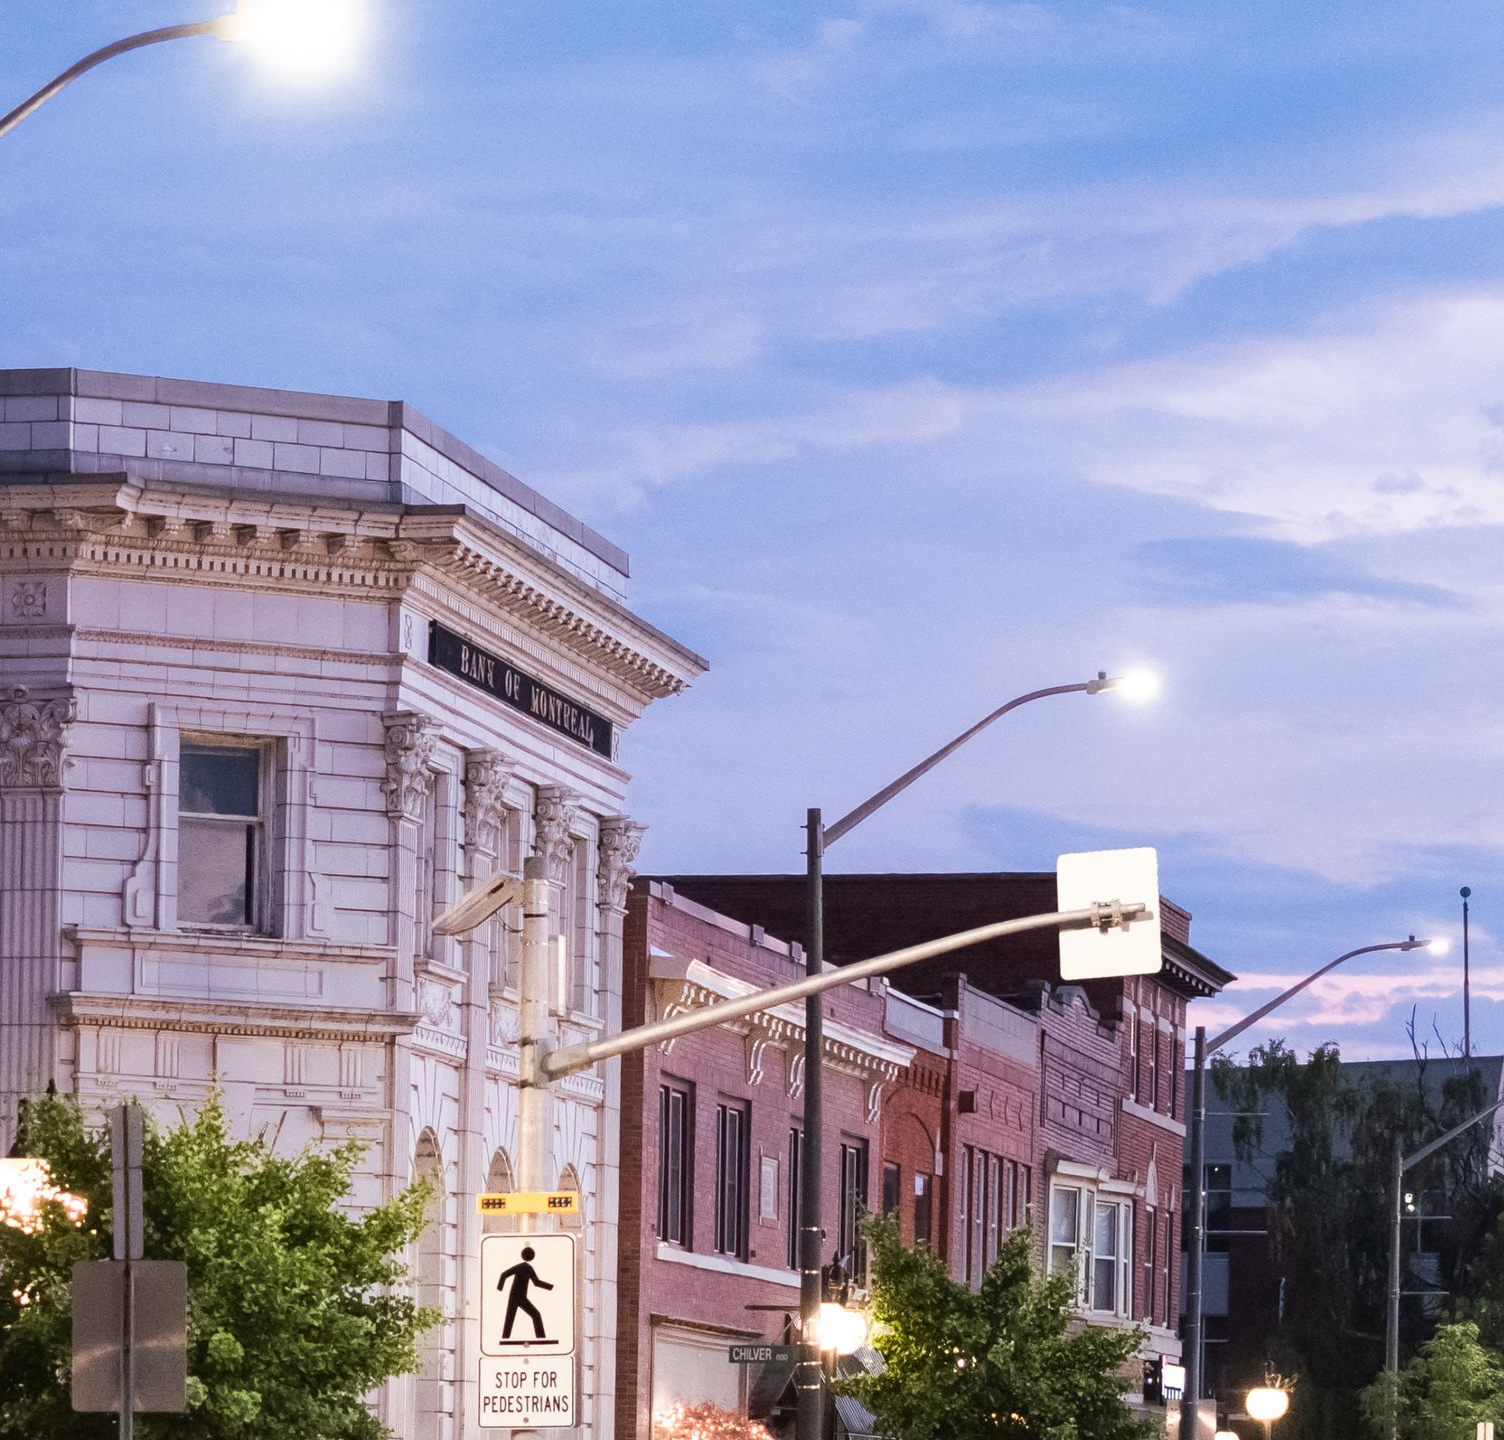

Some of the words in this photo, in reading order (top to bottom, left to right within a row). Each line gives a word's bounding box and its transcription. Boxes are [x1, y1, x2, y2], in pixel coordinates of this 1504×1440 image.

[460, 644, 495, 688] BANK
[505, 669, 522, 701] OF
[530, 685, 594, 749] MONTREAL
[732, 1347, 772, 1361] CHILVER
[495, 1371, 527, 1389] STOP
[533, 1371, 557, 1388] FOR
[483, 1395, 569, 1413] PEDESTRIANS
